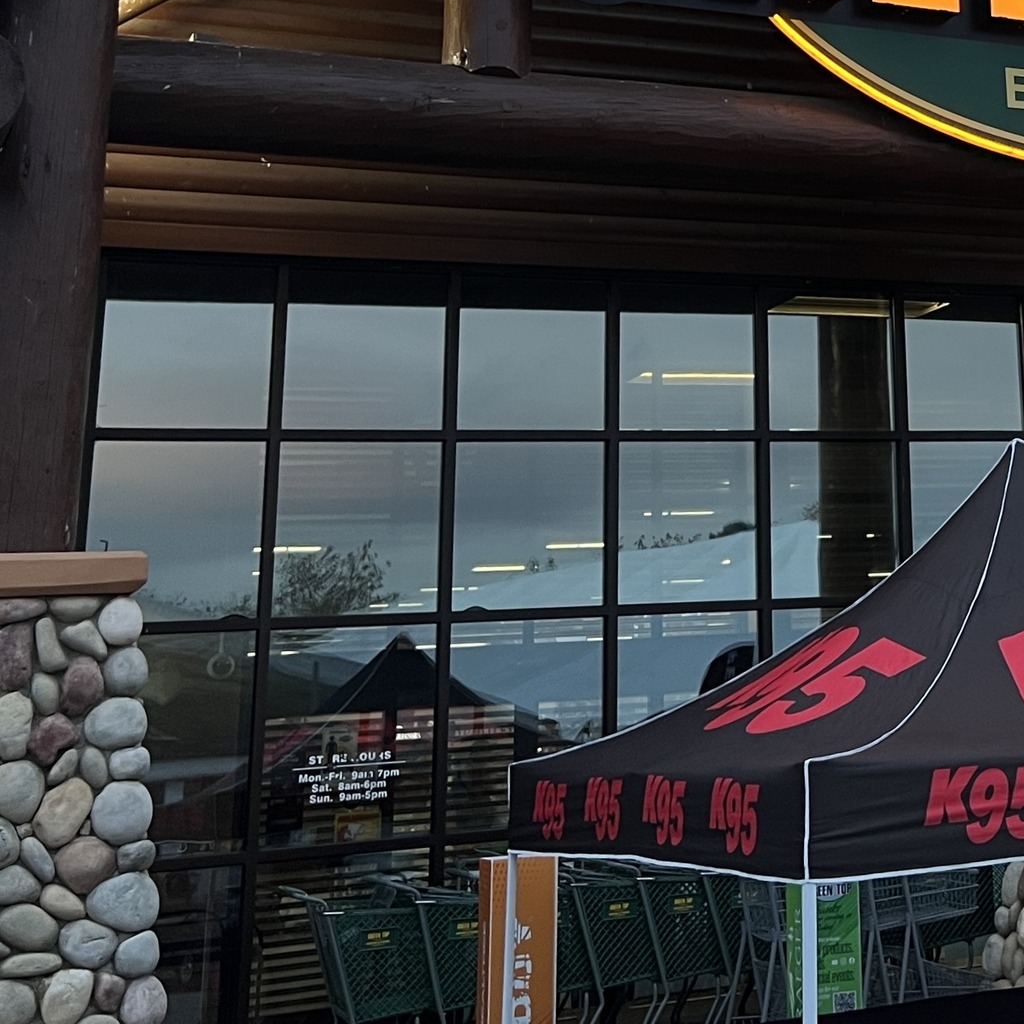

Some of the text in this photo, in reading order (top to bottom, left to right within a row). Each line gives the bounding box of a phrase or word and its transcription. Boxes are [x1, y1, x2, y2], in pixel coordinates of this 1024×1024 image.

[308, 750, 392, 766] STRE OUS
[309, 790, 388, 805] Sun. 9am-5pm
[311, 780, 387, 794] Sat. 8am-6pm
[533, 780, 568, 841] K95
[584, 776, 623, 841] K95
[642, 774, 687, 846] K95
[709, 777, 760, 856] K95
[817, 883, 852, 897] EEN TOP
